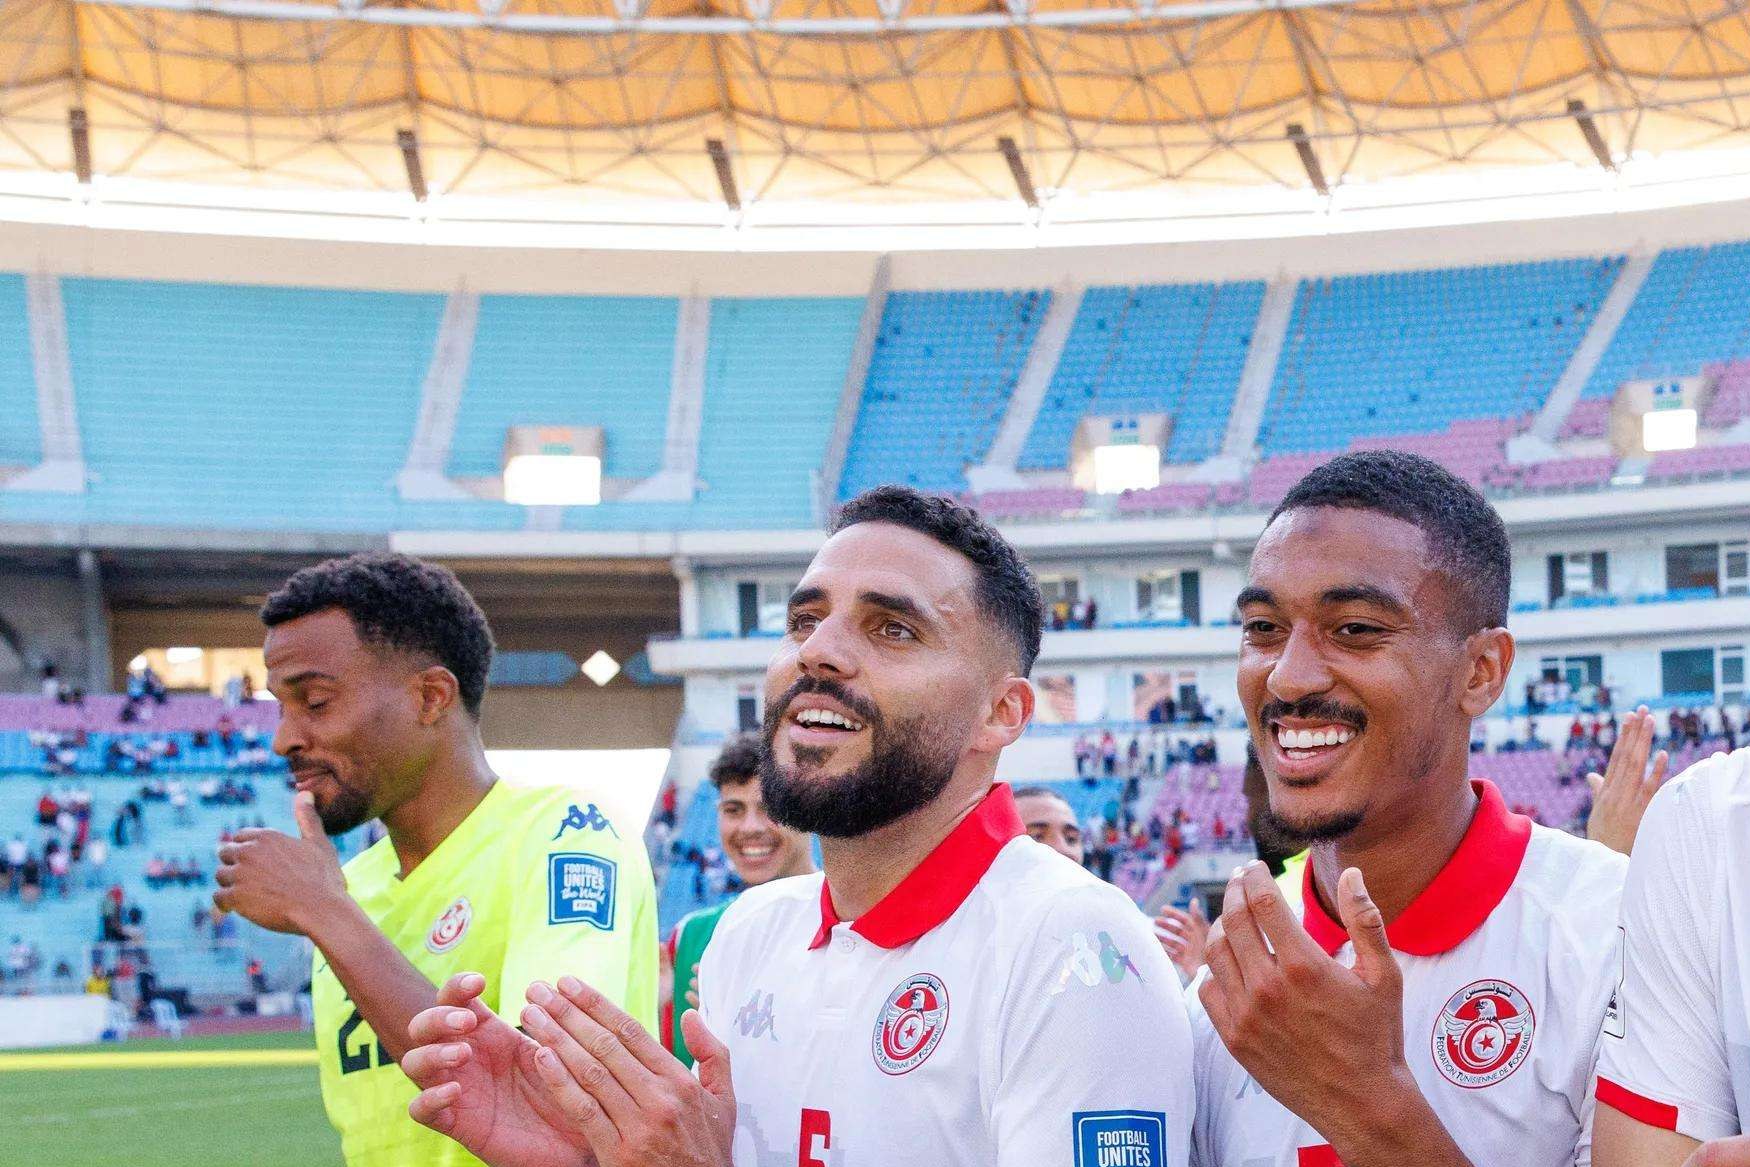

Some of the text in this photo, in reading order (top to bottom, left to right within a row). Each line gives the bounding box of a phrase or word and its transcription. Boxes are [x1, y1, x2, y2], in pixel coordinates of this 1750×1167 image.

[339, 994, 397, 1075] 2
[1456, 1071, 1498, 1084] TUNISIENNE
[1500, 1067, 1509, 1077] DE
[1097, 1130, 1150, 1146] FOOTBALL
[1098, 1146, 1151, 1167] UNITES
